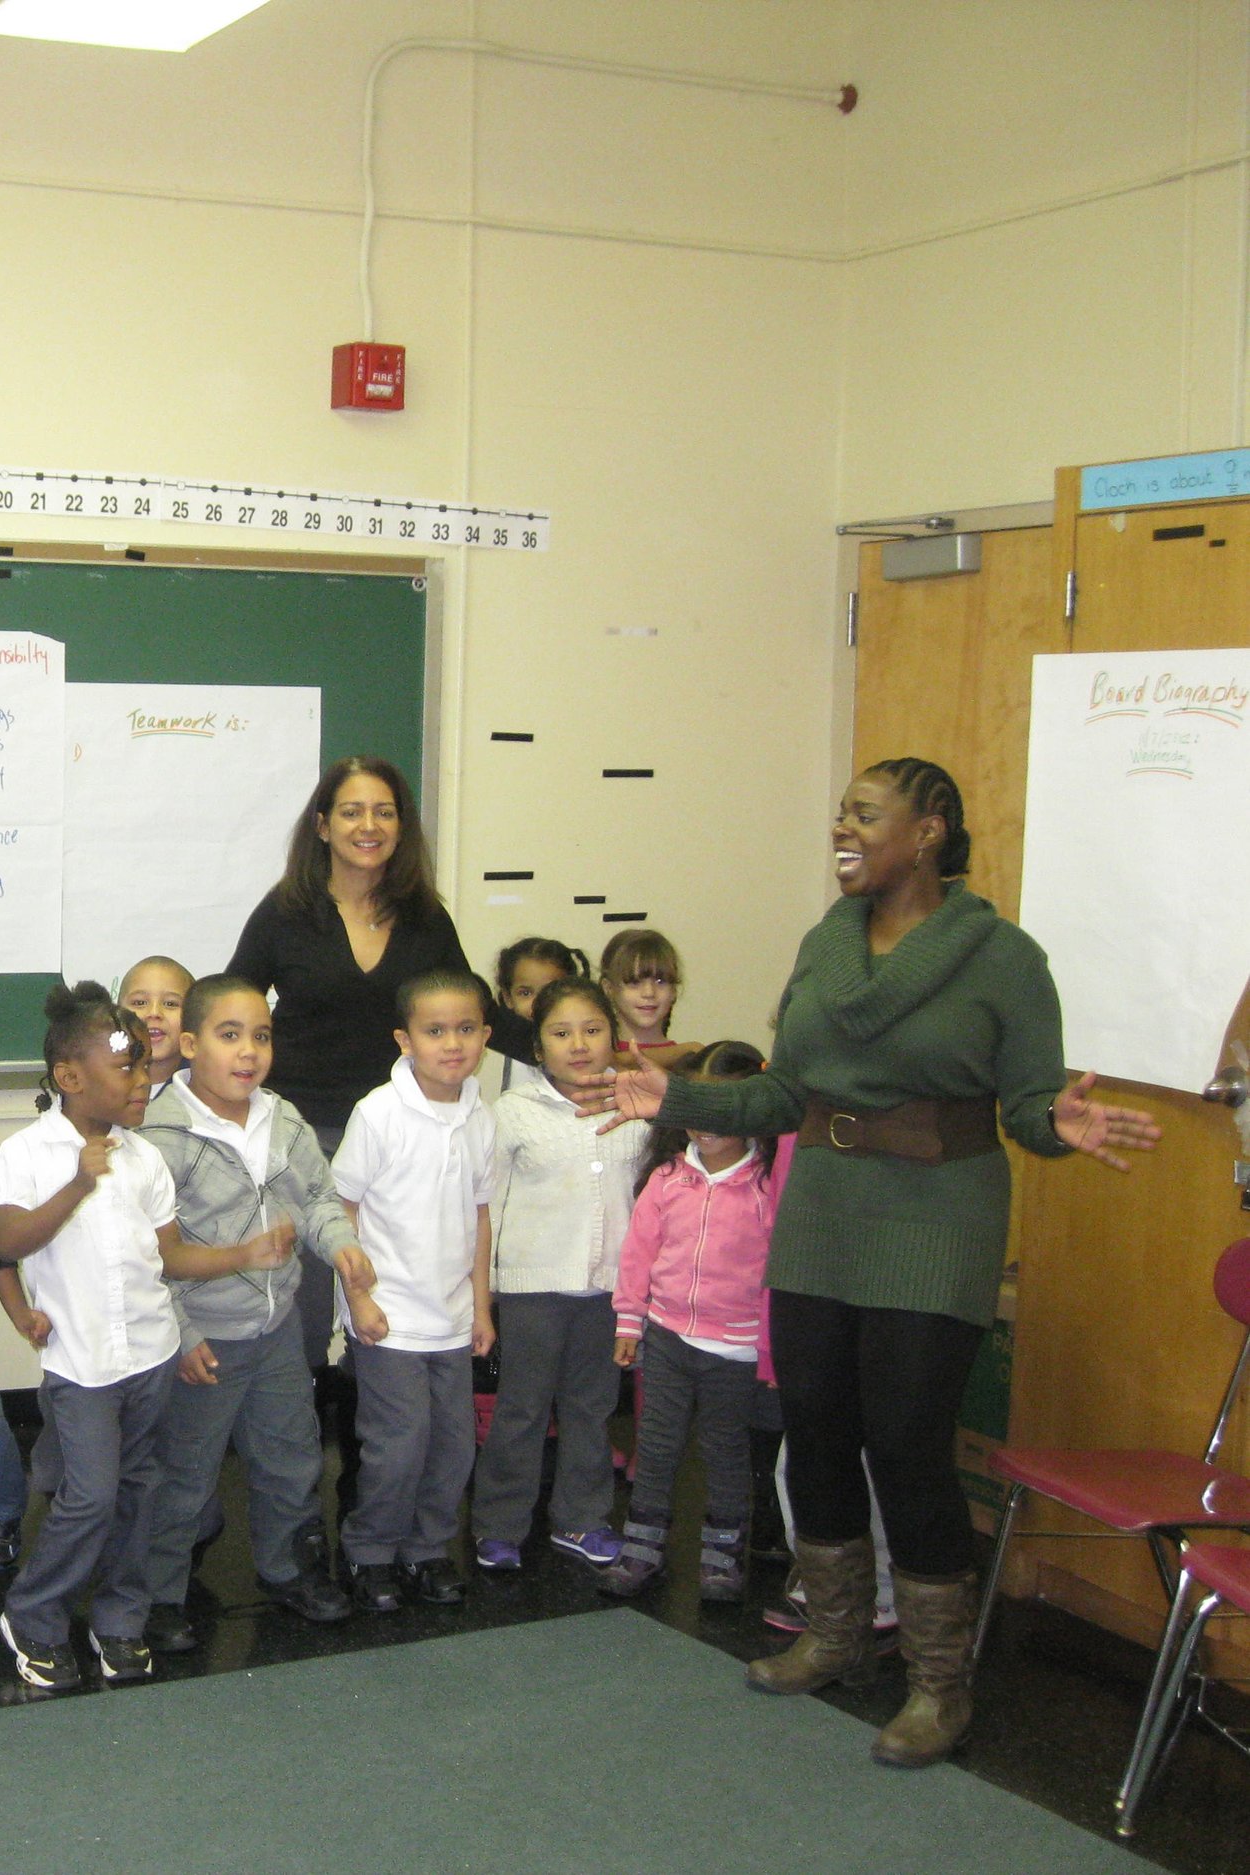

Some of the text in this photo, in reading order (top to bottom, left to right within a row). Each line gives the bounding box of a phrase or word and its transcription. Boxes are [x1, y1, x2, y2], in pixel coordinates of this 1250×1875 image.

[372, 372, 394, 383] FIRE
[30, 492, 46, 510] 21
[65, 494, 83, 512] 22
[100, 495, 118, 514] 23
[133, 497, 151, 516] 24
[172, 500, 189, 519] 25
[205, 503, 223, 522] 26
[238, 506, 256, 524] 27
[271, 509, 288, 528] 28
[303, 511, 322, 530] 29
[336, 514, 353, 533] 30
[368, 517, 383, 535] 31
[399, 520, 416, 538] 32
[431, 523, 450, 541] 33
[464, 525, 480, 544] 34
[493, 528, 508, 546] 35
[521, 530, 537, 549] 36
[127, 708, 218, 731] Teamwork
